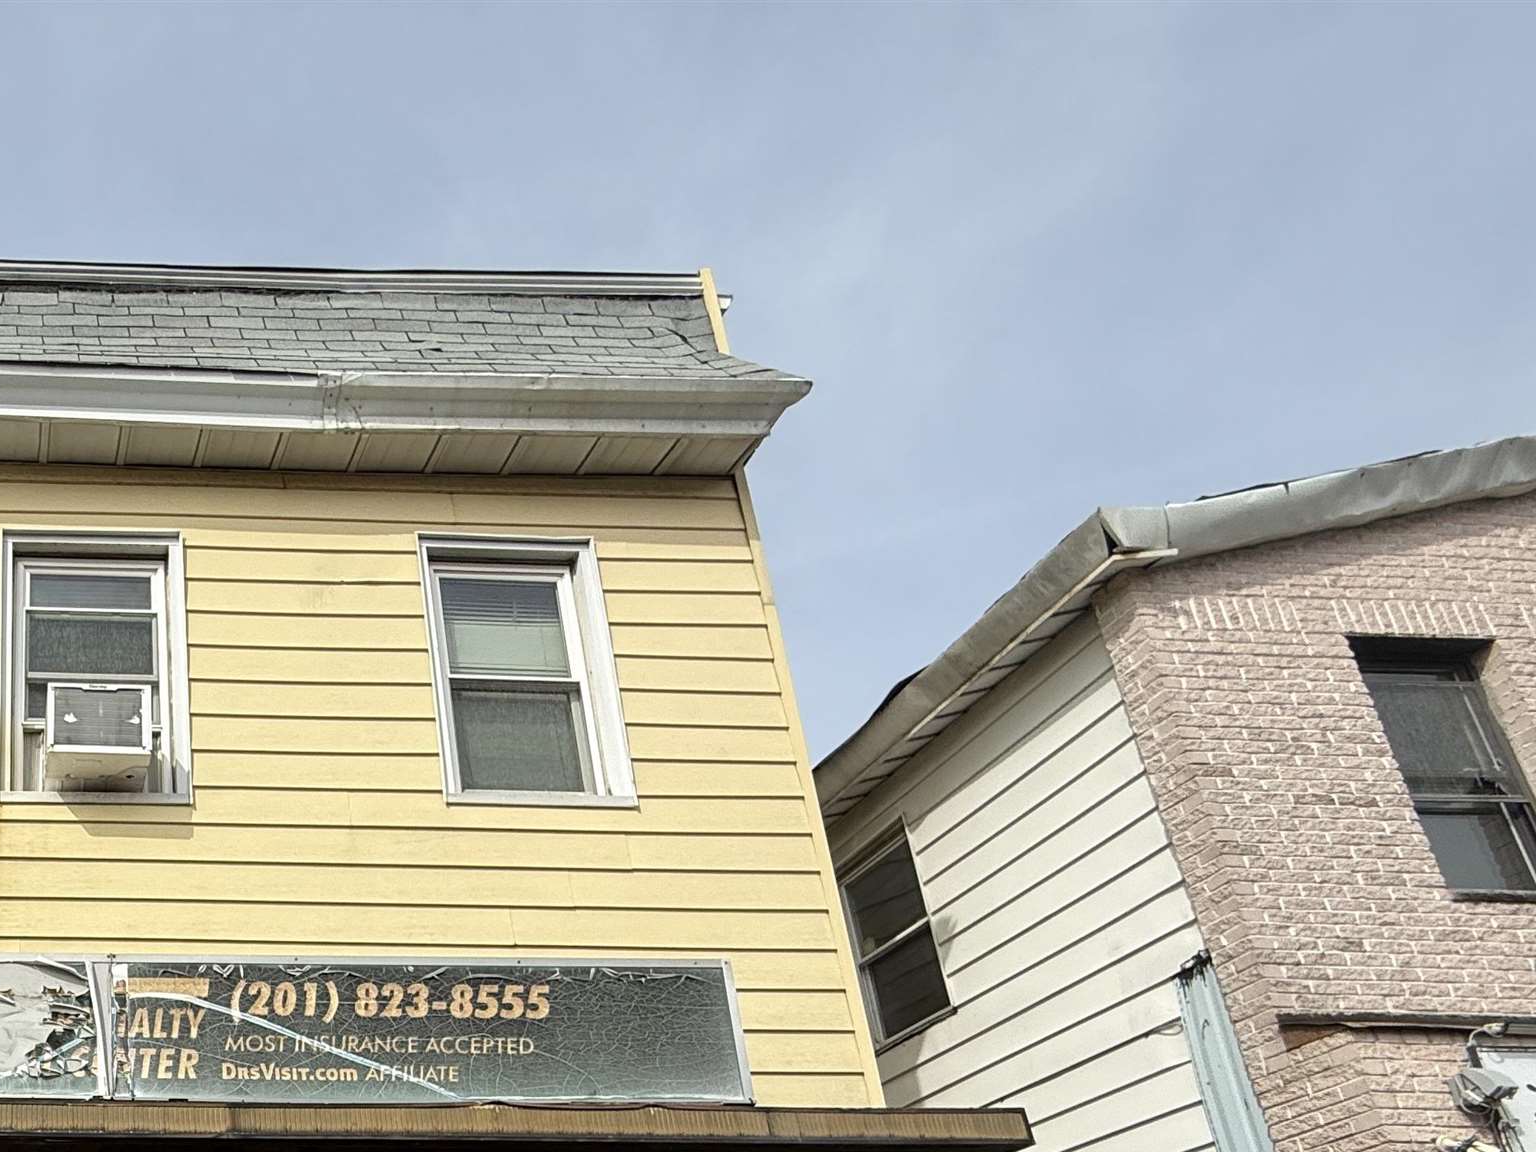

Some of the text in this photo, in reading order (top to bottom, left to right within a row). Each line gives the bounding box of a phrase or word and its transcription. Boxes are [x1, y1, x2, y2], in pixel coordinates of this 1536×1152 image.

[230, 979, 551, 1024] (201) 823-8555
[224, 1034, 535, 1055] MOST INSURANCE ACCEPTED
[364, 1065, 460, 1082] AFFILIATE
